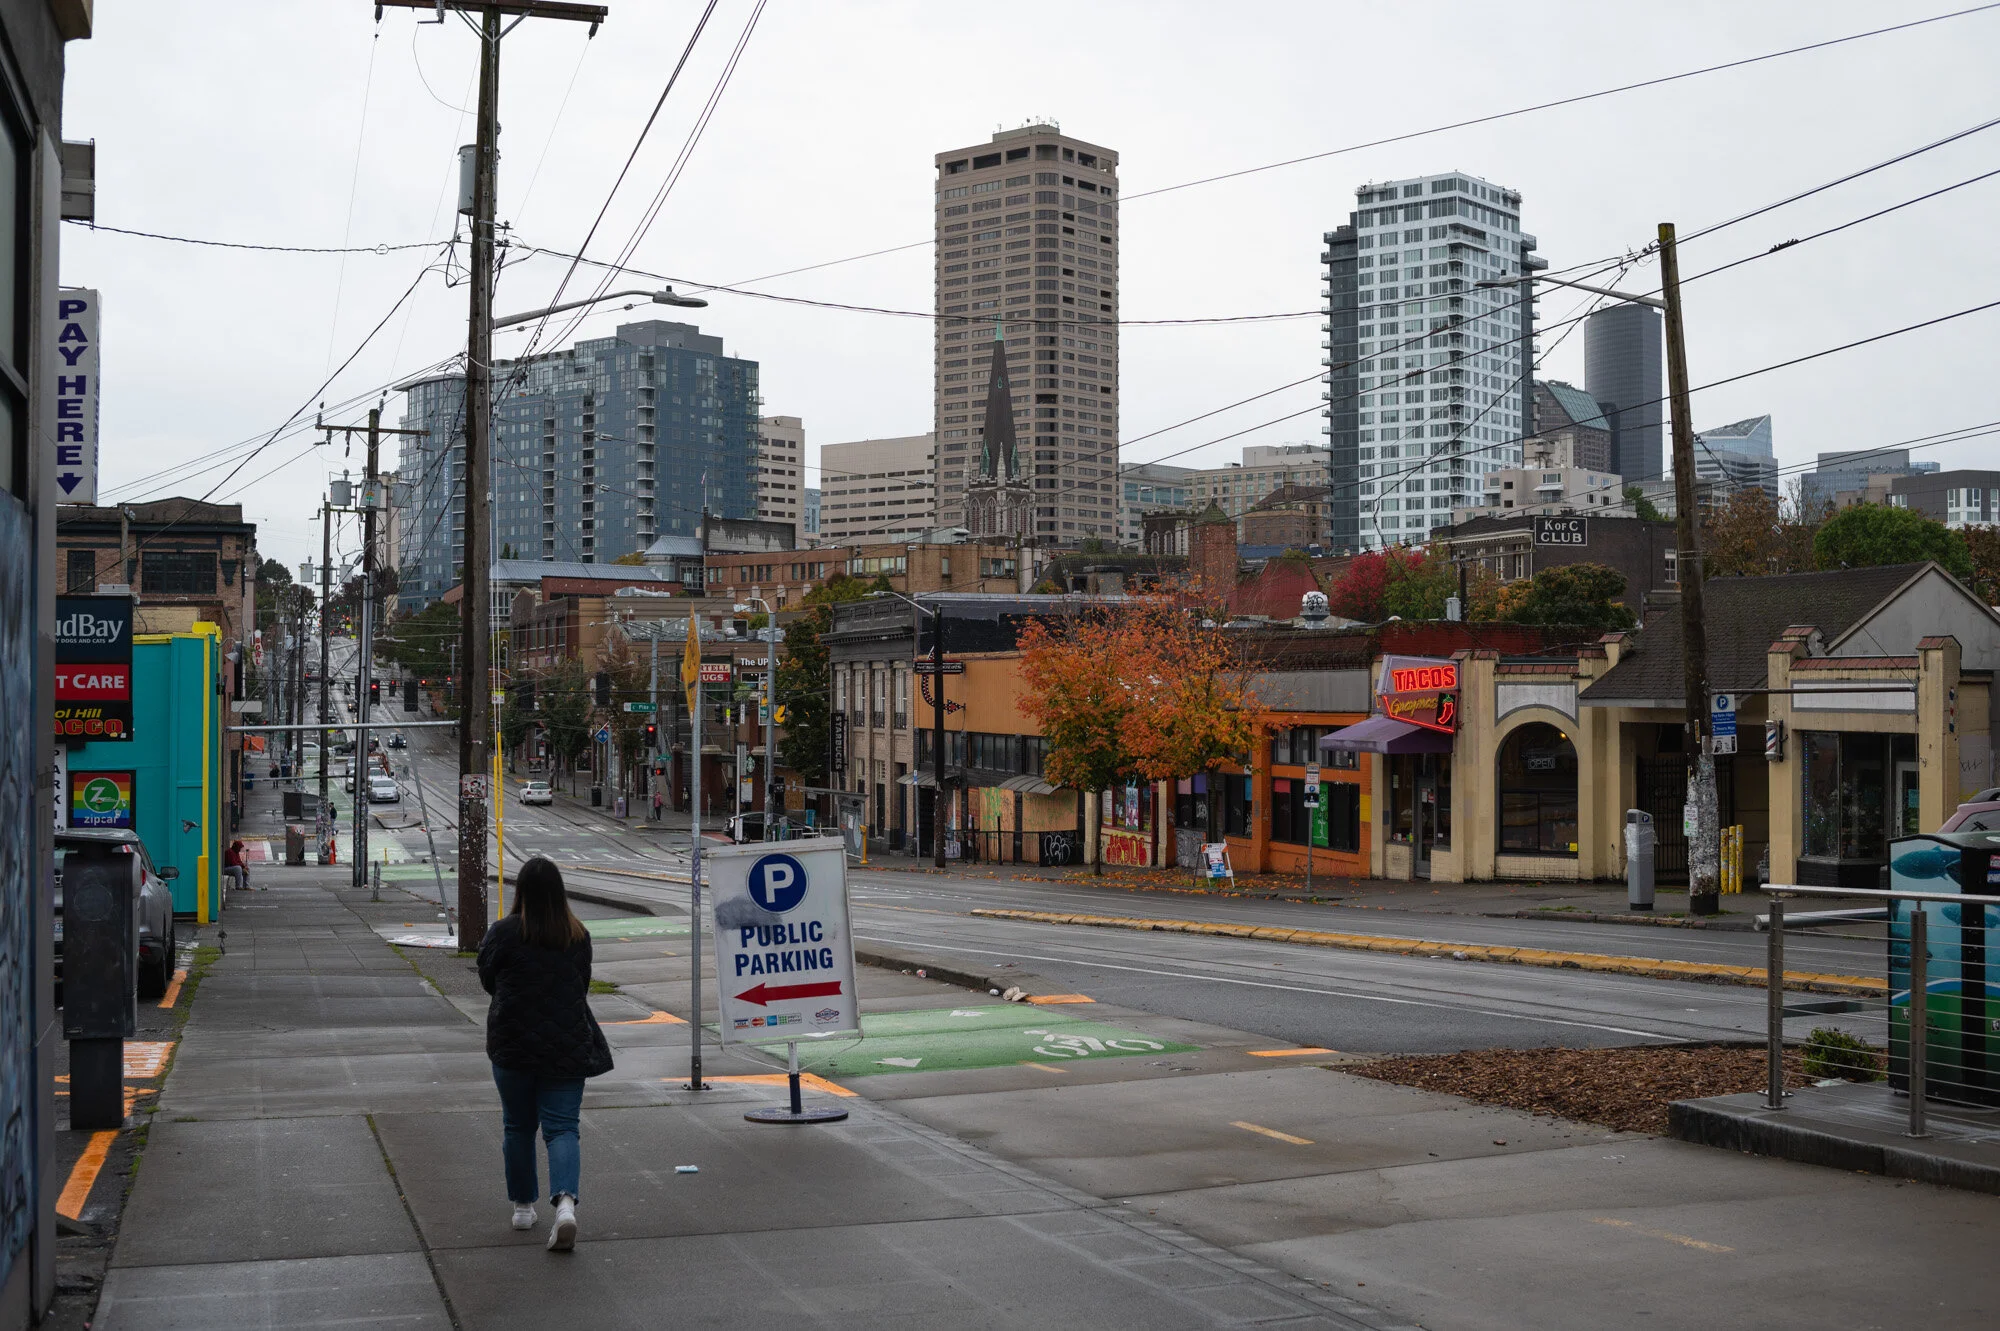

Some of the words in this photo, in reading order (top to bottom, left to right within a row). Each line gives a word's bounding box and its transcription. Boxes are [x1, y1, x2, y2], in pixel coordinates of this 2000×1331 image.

[58, 299, 88, 366] PAY
[57, 375, 87, 466] HERE
[1544, 520, 1553, 530] K
[1569, 520, 1579, 531] C
[1540, 532, 1582, 543] CLUB
[740, 657, 756, 666] The
[757, 658, 769, 666] UP
[72, 674, 125, 689] CARE
[1392, 664, 1457, 692] TACOS
[1719, 698, 1726, 708] P
[75, 708, 102, 718] Hill
[1529, 759, 1555, 768] OPEN
[53, 749, 61, 831] PARKI
[84, 813, 118, 826] zipcar
[763, 862, 795, 904] P
[740, 920, 823, 948] PUBLIC
[735, 947, 834, 977] PARKING
